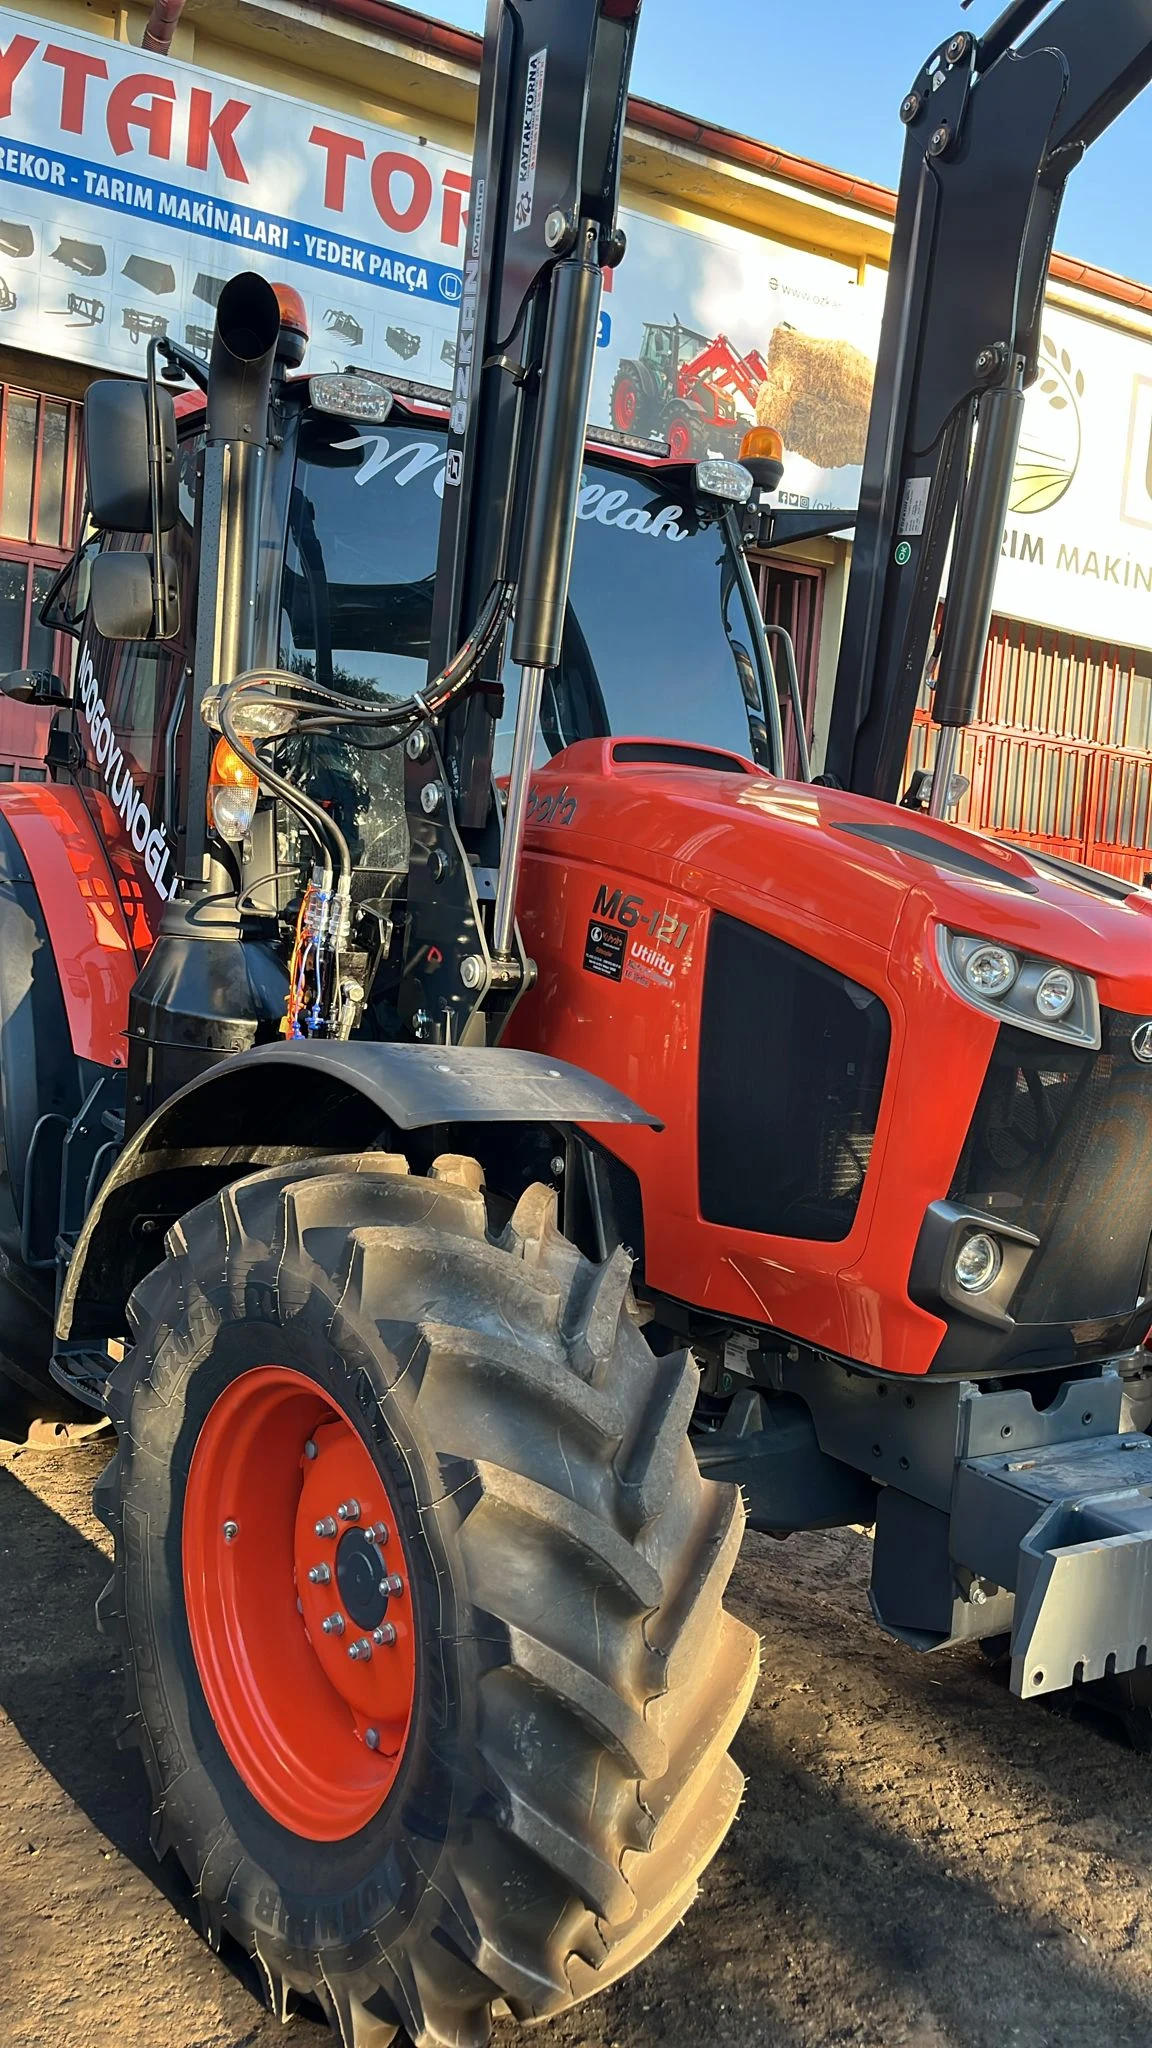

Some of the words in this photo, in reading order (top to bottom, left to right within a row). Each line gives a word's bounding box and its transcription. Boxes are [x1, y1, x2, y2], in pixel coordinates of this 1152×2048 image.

[84, 170, 152, 210] TARIM
[158, 192, 288, 250] MAKİNALARI
[304, 234, 365, 280] YEDEK
[369, 257, 428, 291] PARÇA
[592, 884, 689, 949] M6-121
[630, 942, 675, 977] Utility
